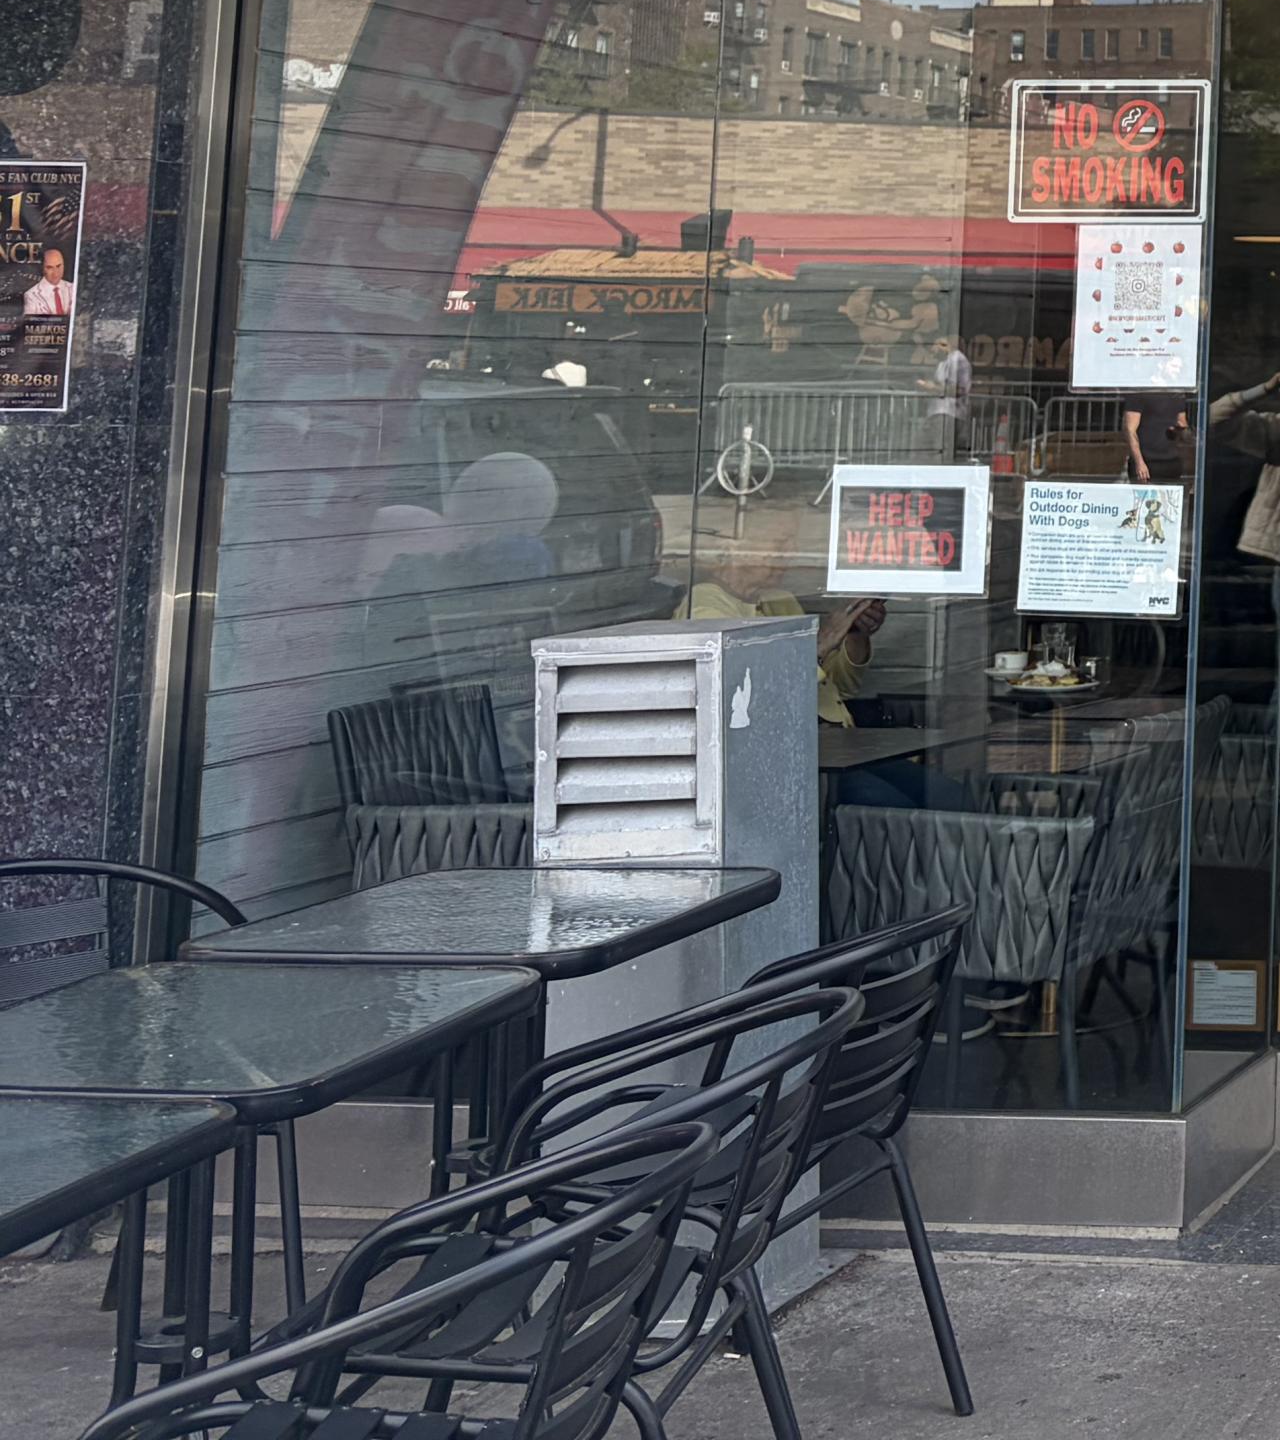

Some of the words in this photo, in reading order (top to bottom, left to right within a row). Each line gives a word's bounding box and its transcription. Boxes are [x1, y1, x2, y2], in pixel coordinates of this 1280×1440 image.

[1052, 103, 1099, 150] NO
[8, 173, 29, 183] FAN
[30, 173, 57, 183] CLUB
[59, 173, 80, 183] NYC
[1031, 156, 1185, 203] SMOKING
[25, 325, 66, 334] MARKOS
[1030, 488, 1063, 500] Rules
[1066, 488, 1083, 500] for
[868, 489, 934, 527] HELP
[1030, 501, 1078, 513] Outdoor
[1081, 503, 1119, 516] Dining
[1029, 515, 1055, 527] With
[1058, 516, 1090, 529] Dogs
[846, 529, 956, 566] WANTED
[1149, 597, 1170, 605] NYC
